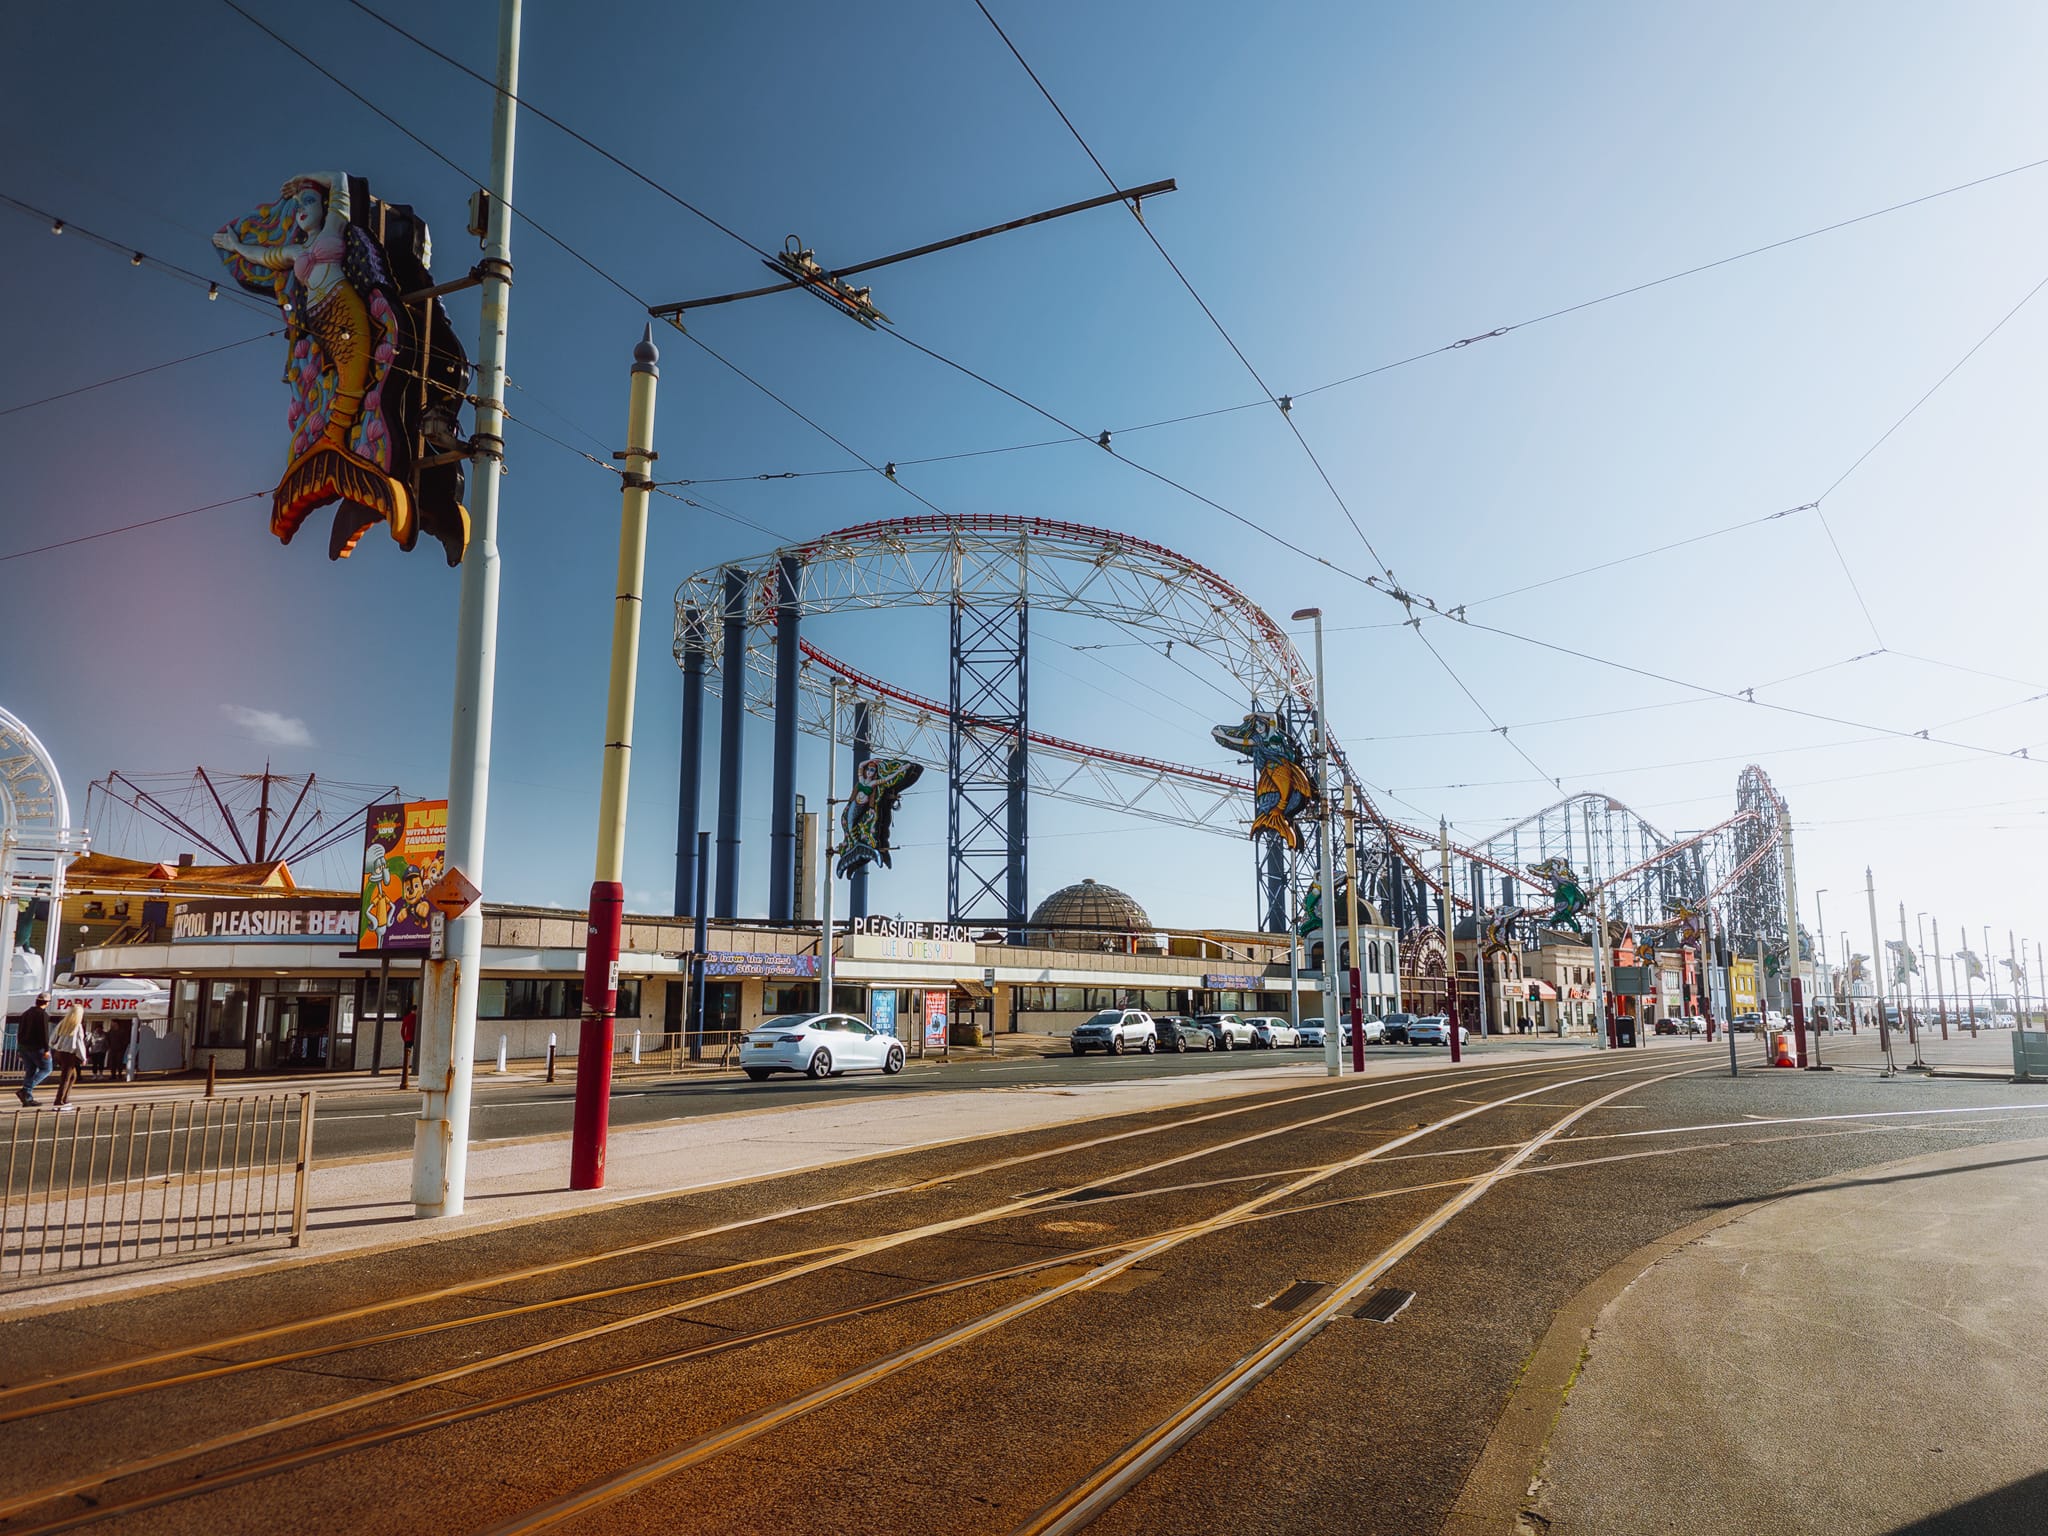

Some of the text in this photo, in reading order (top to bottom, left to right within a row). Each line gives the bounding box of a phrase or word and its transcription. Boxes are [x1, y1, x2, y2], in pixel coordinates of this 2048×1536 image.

[405, 828, 427, 836] WITH
[211, 911, 302, 936] PLEASURE
[854, 917, 972, 943] PLEASURE BEACH
[735, 964, 763, 974] Stitch
